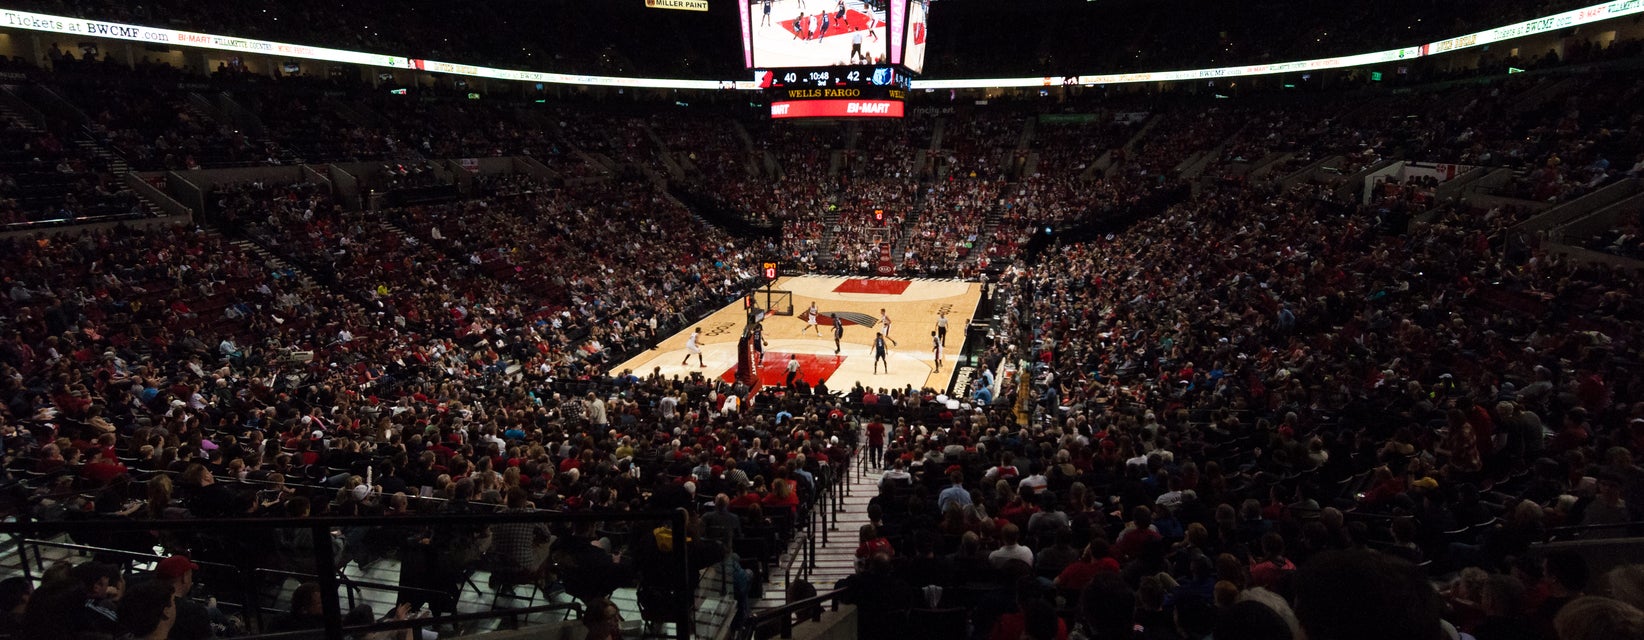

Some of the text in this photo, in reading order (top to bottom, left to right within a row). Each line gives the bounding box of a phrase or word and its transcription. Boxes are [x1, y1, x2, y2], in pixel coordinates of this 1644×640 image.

[5, 13, 63, 30] Tickets
[68, 22, 82, 32] at
[178, 33, 211, 44] BI-MART
[784, 72, 797, 83] 40
[809, 71, 829, 80] 10:48
[847, 71, 860, 81] 42
[789, 88, 860, 97] WELLS FARGO
[847, 102, 890, 113] BI-MART
